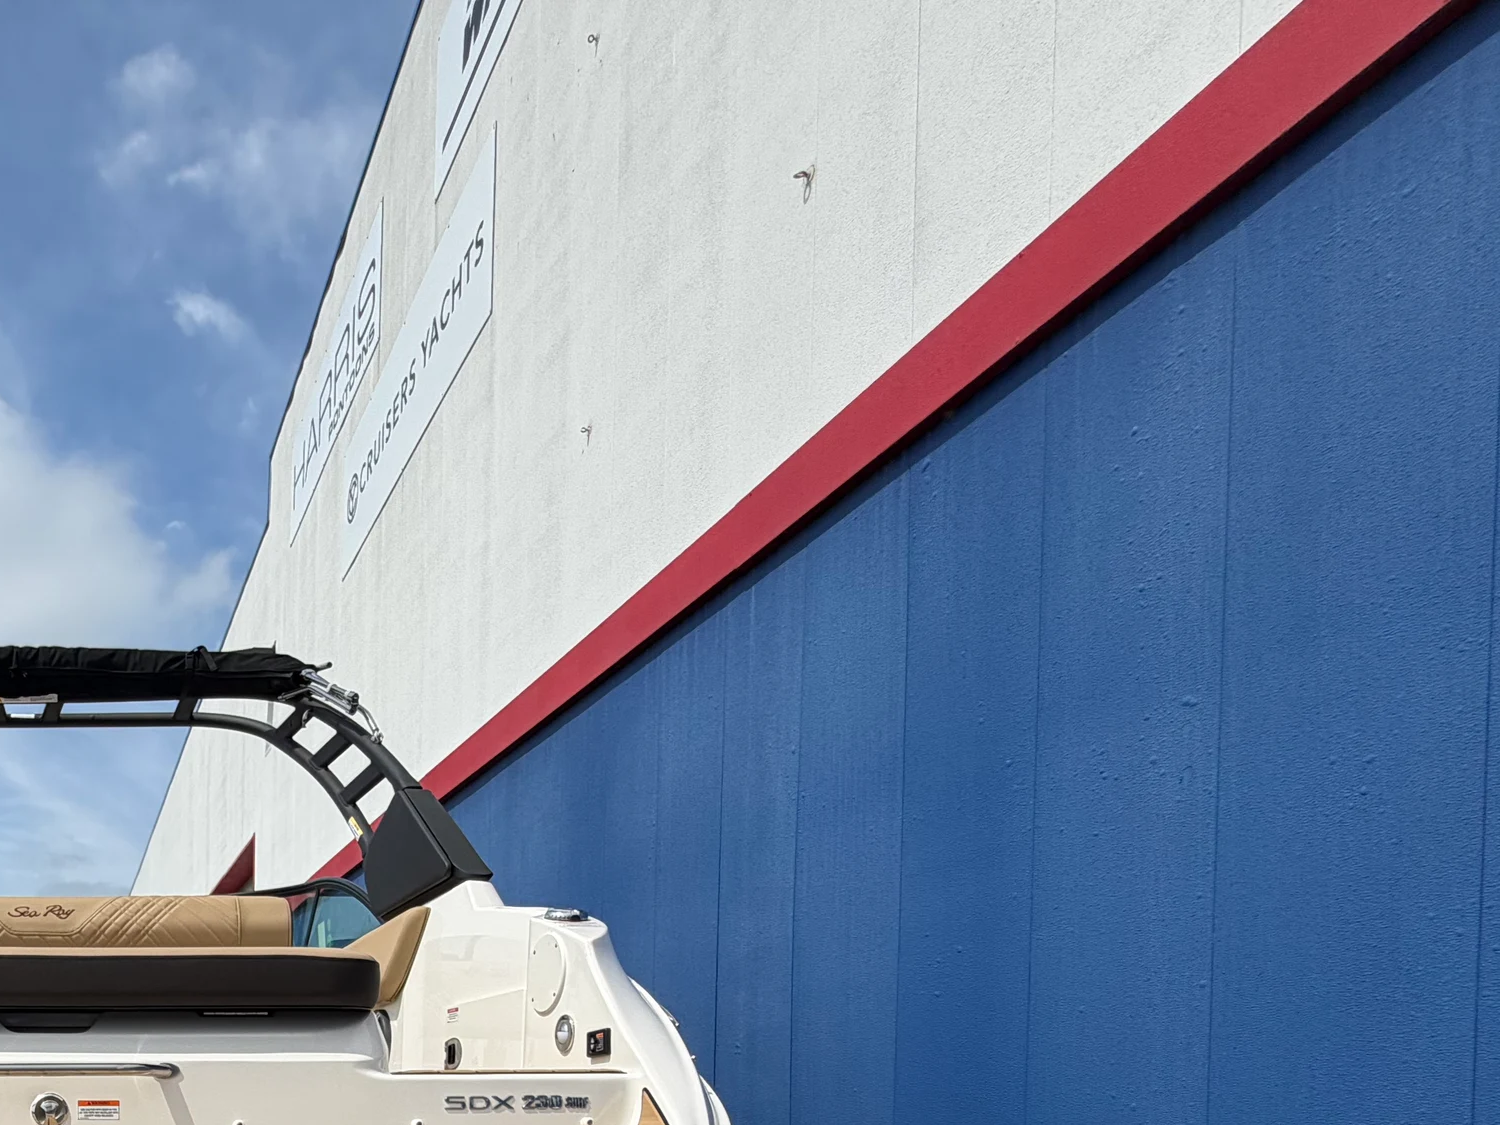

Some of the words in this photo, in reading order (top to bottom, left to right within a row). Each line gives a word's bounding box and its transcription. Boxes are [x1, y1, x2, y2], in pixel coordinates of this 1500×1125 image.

[293, 258, 376, 511] HARRIS
[328, 322, 375, 442] PONTOONS
[359, 358, 417, 493] CRUISERS
[421, 220, 485, 368] YACHTS
[7, 906, 41, 918] Sea
[43, 904, 76, 920] Ray
[444, 1095, 515, 1111] SDX
[522, 1095, 563, 1110] 230
